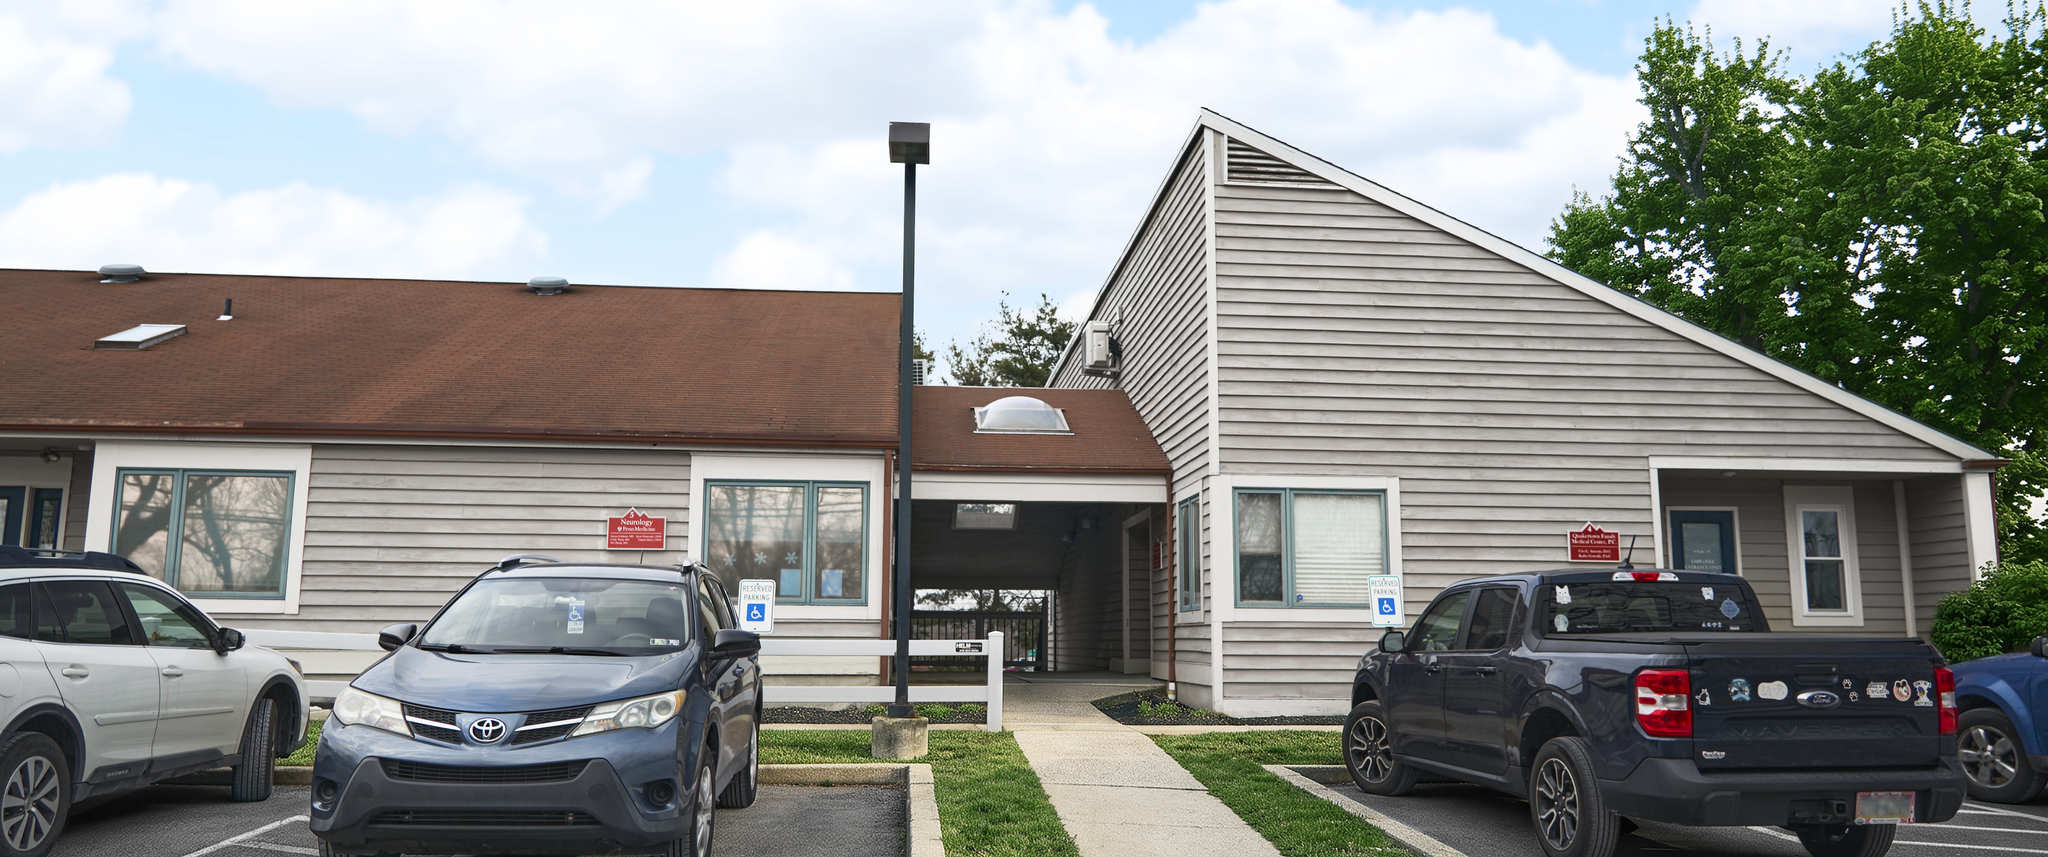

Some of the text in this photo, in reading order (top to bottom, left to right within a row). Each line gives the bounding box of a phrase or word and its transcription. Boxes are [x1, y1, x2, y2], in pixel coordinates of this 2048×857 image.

[743, 593, 770, 601] PARKING
[1812, 694, 1831, 704] Ford
[1728, 724, 1904, 738] MAVERCK
